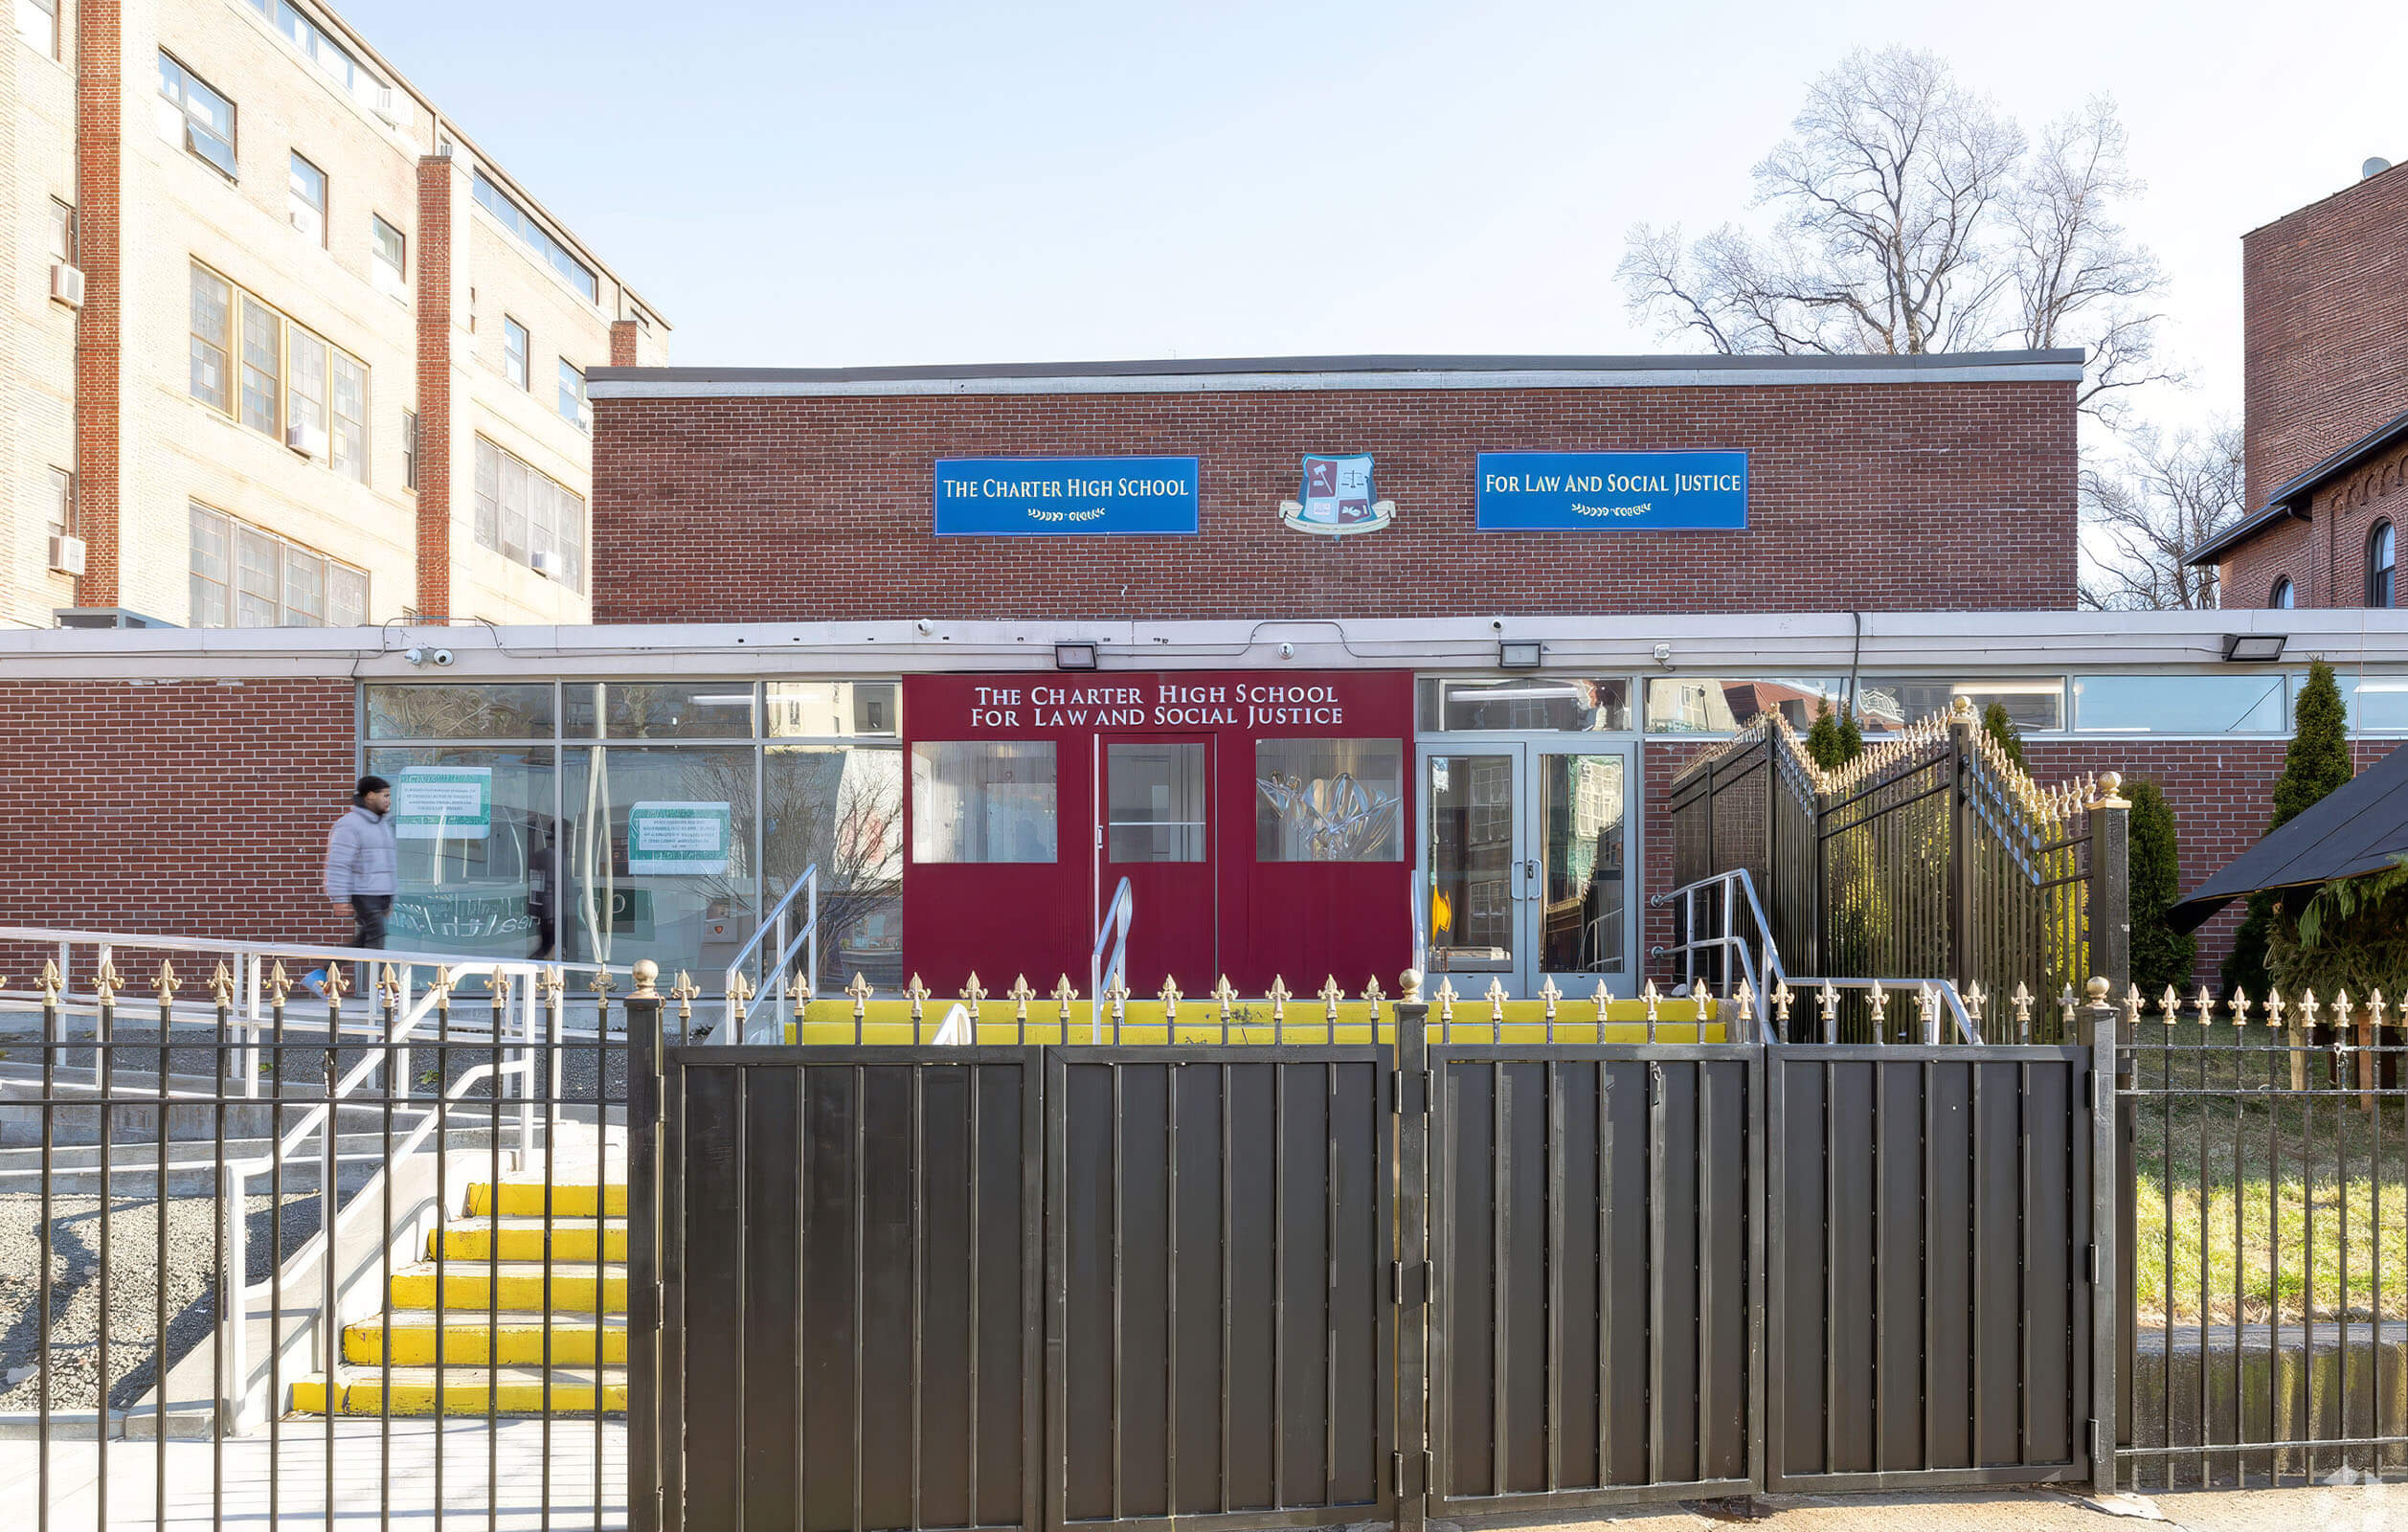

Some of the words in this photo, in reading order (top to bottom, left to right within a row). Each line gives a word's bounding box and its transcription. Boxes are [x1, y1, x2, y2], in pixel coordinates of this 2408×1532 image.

[943, 479, 978, 498] THE
[983, 478, 1062, 498] CHARTER
[1068, 478, 1112, 497] HIGH
[1117, 478, 1189, 497] SCHOOL
[1485, 474, 1520, 492] FOR
[1526, 474, 1561, 492] LAW
[1564, 474, 1603, 492] AND
[1607, 473, 1670, 492] SOCIAL
[1674, 473, 1741, 497] JUSTICE
[974, 687, 1022, 706] THE
[1031, 686, 1144, 706] CHARTER
[1159, 685, 1227, 704] HIGH
[1235, 683, 1339, 704] SCHOOL
[971, 709, 1020, 728] FOR
[1034, 708, 1089, 727] LAW
[1094, 708, 1145, 726] AND
[1154, 706, 1238, 726] SOCIAL
[1248, 705, 1343, 730] JUSTICE
